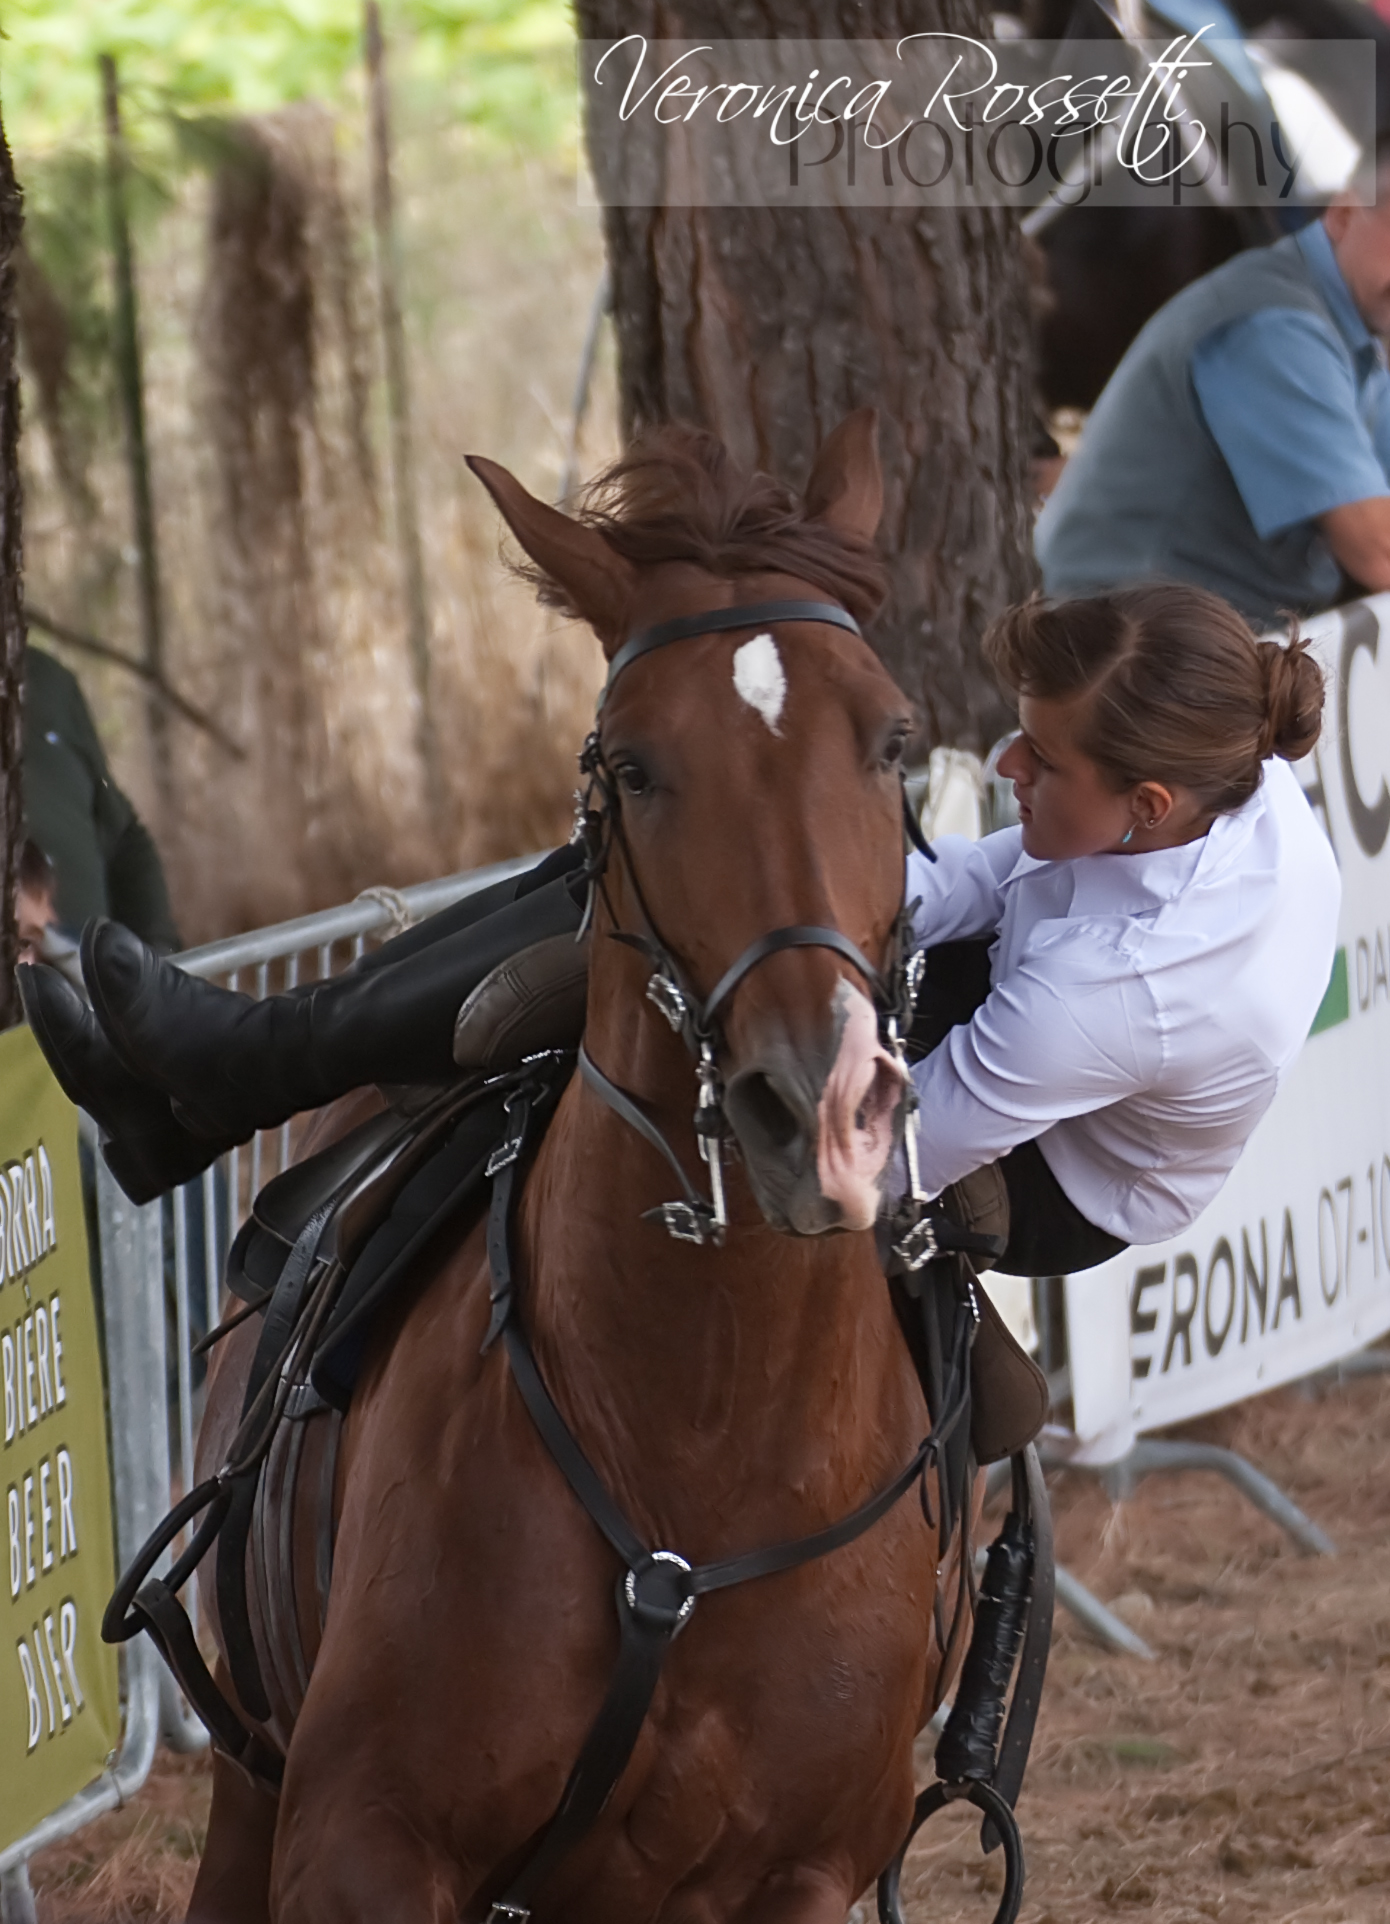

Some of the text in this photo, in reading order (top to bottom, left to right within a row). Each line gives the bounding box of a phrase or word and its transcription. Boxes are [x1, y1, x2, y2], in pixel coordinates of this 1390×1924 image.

[1355, 922, 1390, 1012] DA
[2, 1284, 65, 1442] BIÈRE
[8, 1449, 77, 1597] BEER
[18, 1601, 84, 1749] BIER
